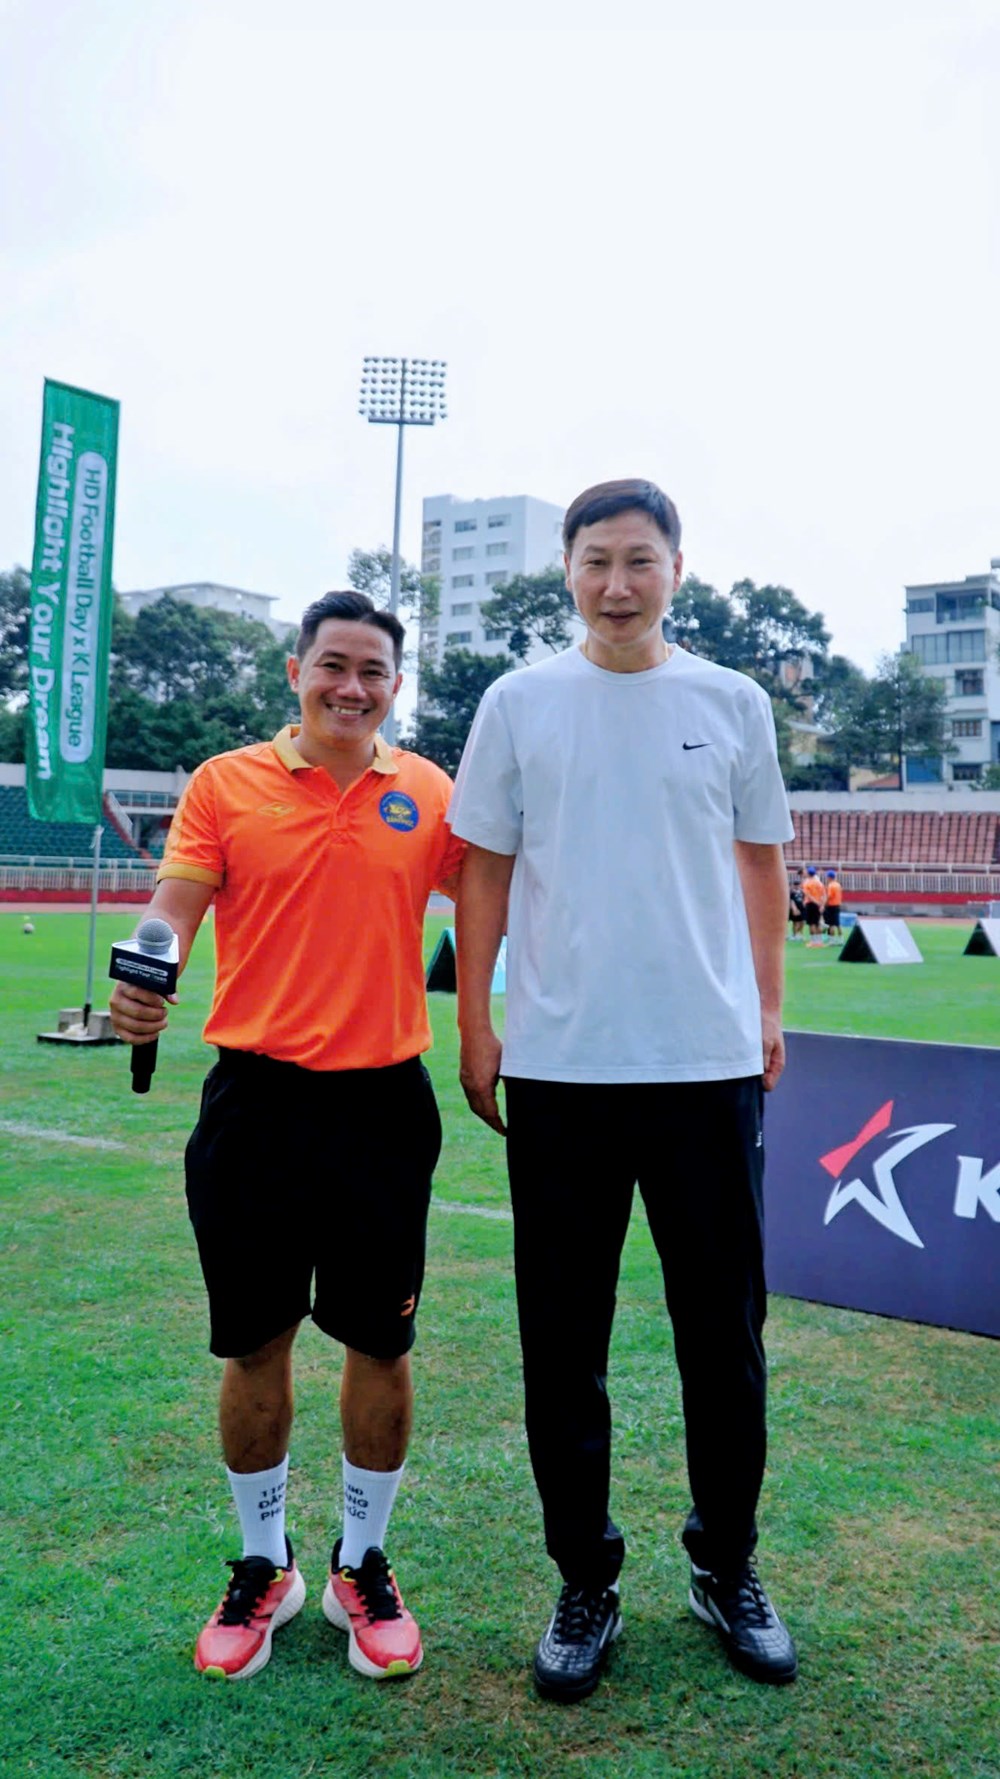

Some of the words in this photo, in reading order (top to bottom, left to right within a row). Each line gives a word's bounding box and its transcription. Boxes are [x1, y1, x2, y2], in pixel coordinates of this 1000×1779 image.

[40, 421, 75, 573] Highlight
[84, 468, 102, 499] HD
[76, 503, 99, 589] Football
[32, 582, 61, 662] Your
[69, 594, 92, 632] Day
[72, 636, 87, 647] x
[71, 652, 91, 667] K
[32, 666, 55, 780] Dream
[65, 671, 89, 747] League
